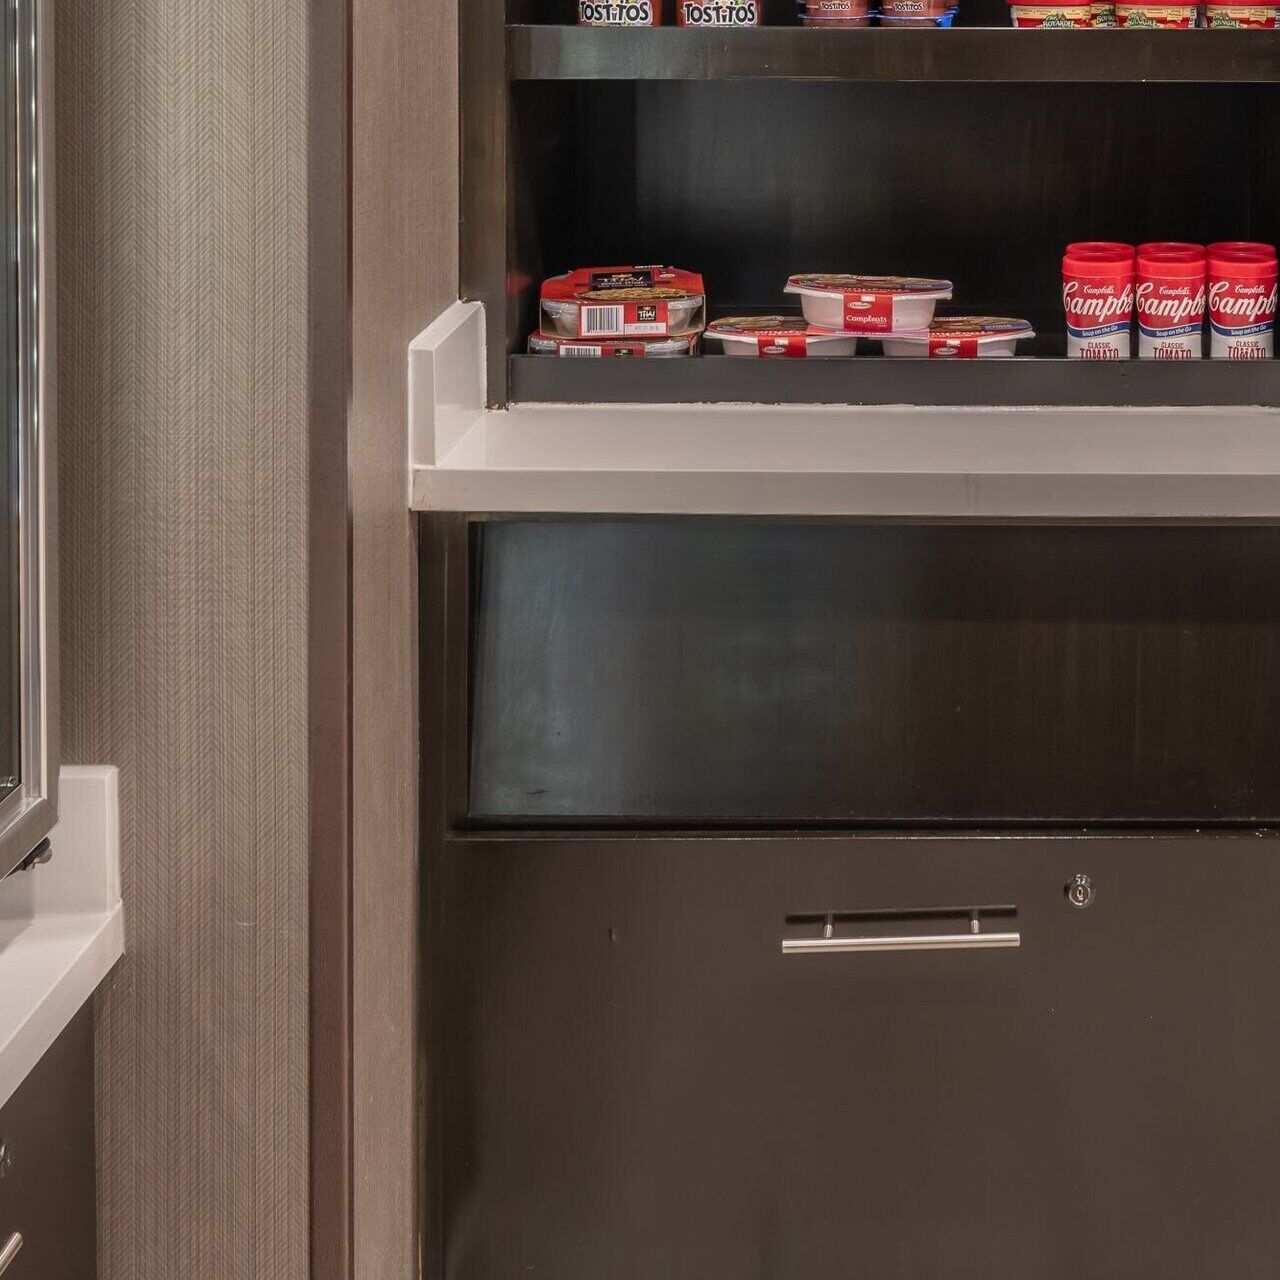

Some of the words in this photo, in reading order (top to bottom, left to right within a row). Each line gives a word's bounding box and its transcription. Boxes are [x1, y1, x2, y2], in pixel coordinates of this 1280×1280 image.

[1083, 284, 1118, 296] Campbell's
[1158, 285, 1193, 296] Campbell's
[1234, 284, 1267, 295] Campbell's
[637, 310, 656, 318] THAI
[1081, 330, 1095, 338] Soup
[1155, 330, 1169, 338] Soup
[1230, 328, 1243, 337] Soup
[1087, 341, 1112, 350] CLASSIC
[1161, 341, 1184, 350] CLASSIC
[1235, 339, 1259, 349] CLASSIC
[1079, 348, 1119, 361] TOMATO
[1152, 348, 1193, 361] TOMATO
[1227, 347, 1267, 361] TOMATO
